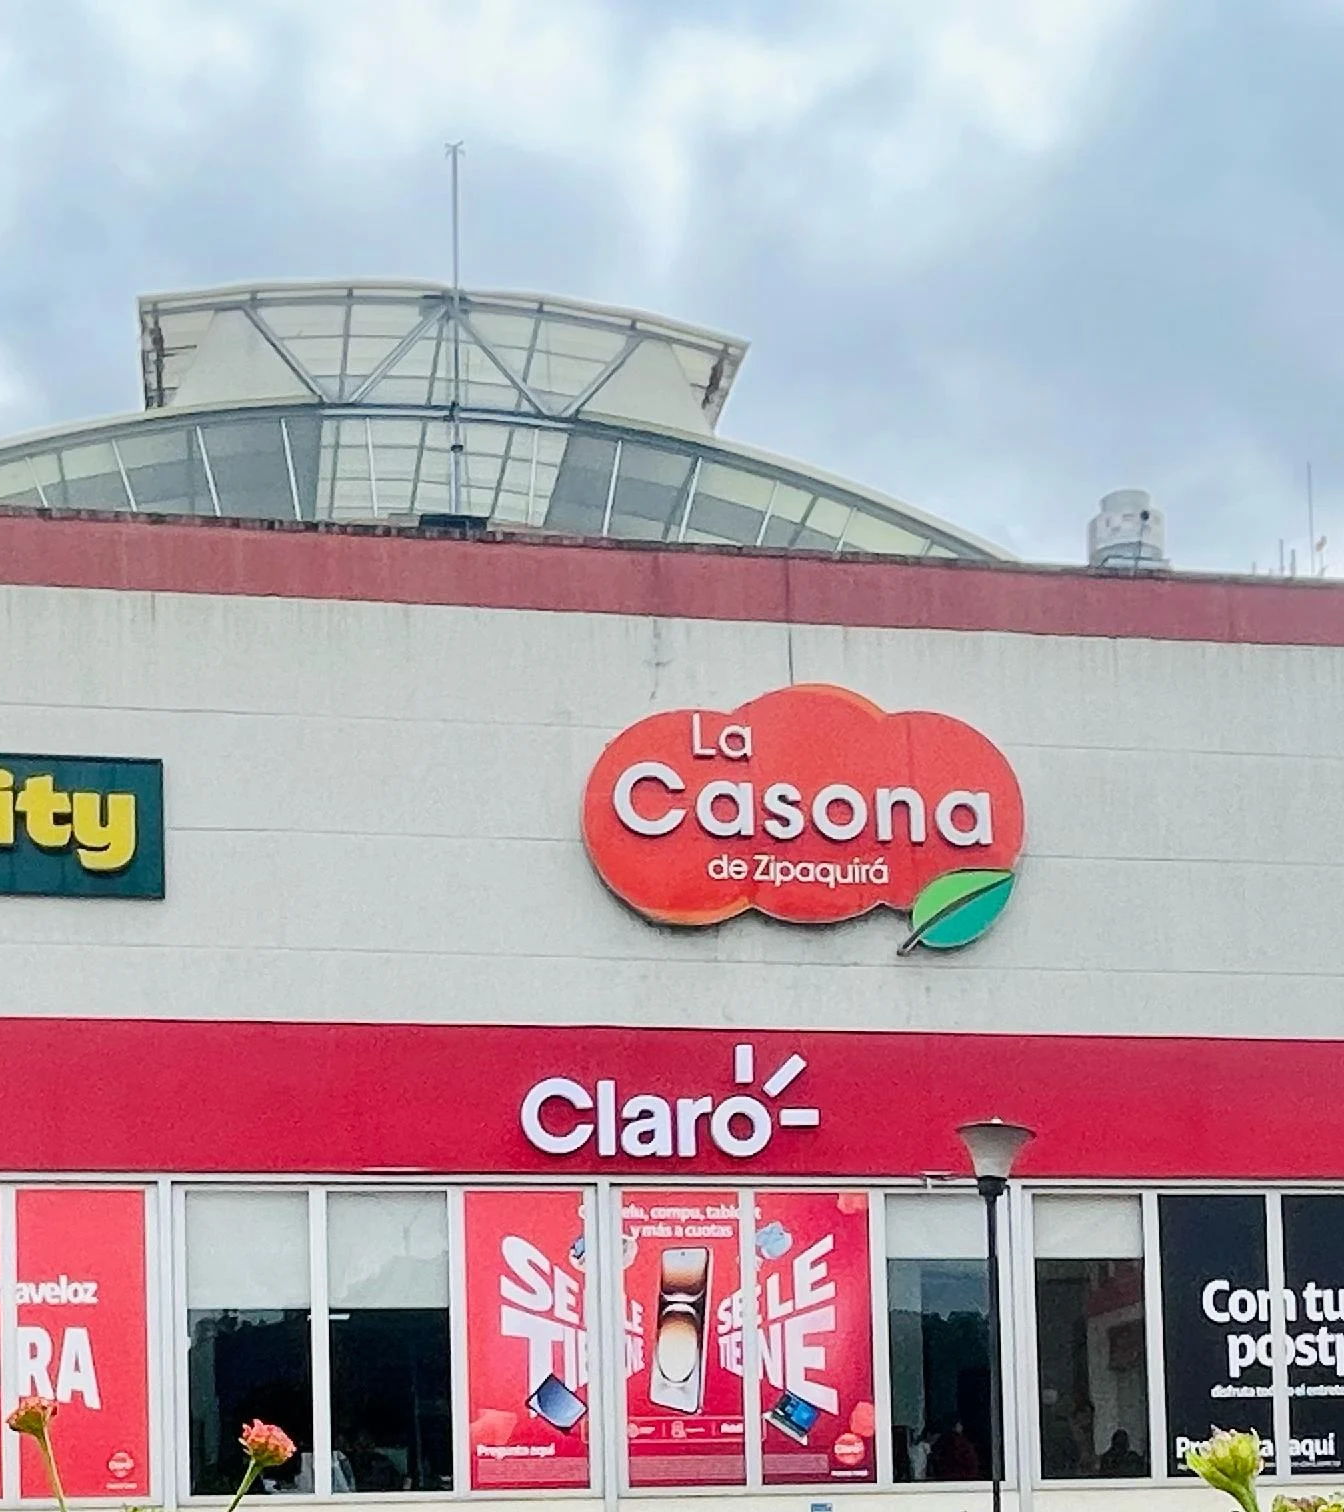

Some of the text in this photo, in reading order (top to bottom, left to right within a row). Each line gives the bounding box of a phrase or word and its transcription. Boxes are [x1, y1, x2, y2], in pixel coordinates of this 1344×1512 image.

[691, 712, 754, 760] La
[613, 761, 995, 848] Casona
[707, 853, 890, 889] de Zipaquirá
[521, 1076, 773, 1159] Claro
[499, 1235, 580, 1324] SE
[766, 1233, 837, 1320] LE
[1288, 1432, 1336, 1461] aquí
